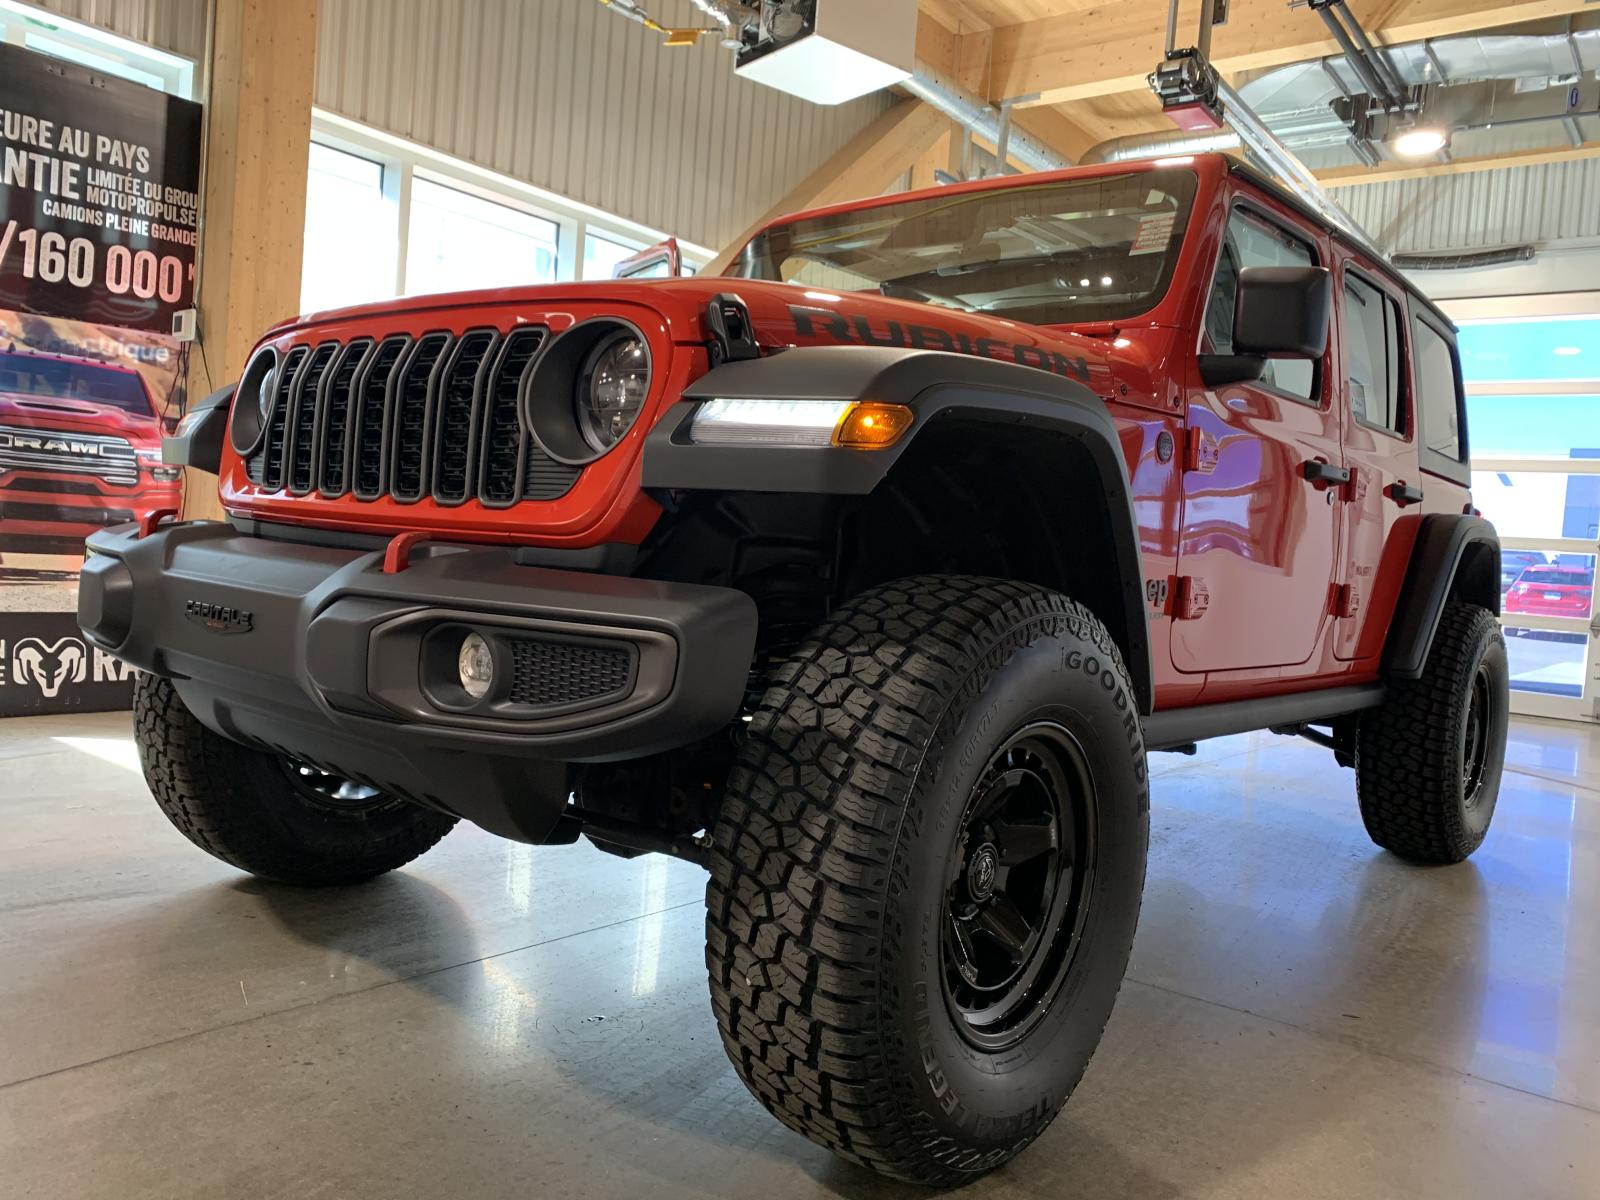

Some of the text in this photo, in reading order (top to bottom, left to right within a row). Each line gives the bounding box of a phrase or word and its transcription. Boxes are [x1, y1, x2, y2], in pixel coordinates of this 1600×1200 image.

[0, 109, 150, 174] URE AU PAYS
[0, 146, 198, 210] NTIE LIMITÉE DU GROU
[42, 199, 197, 247] CAMIONS PLEINE GRANDE
[86, 186, 196, 227] MOTOPROPULSE
[105, 245, 183, 303] 000
[785, 304, 1090, 382] RUBICON
[14, 436, 98, 455] RAM
[185, 599, 254, 627] CAPITALE
[1146, 579, 1168, 608] ep
[93, 645, 141, 682] RA
[1064, 650, 1147, 817] GOODRIDE
